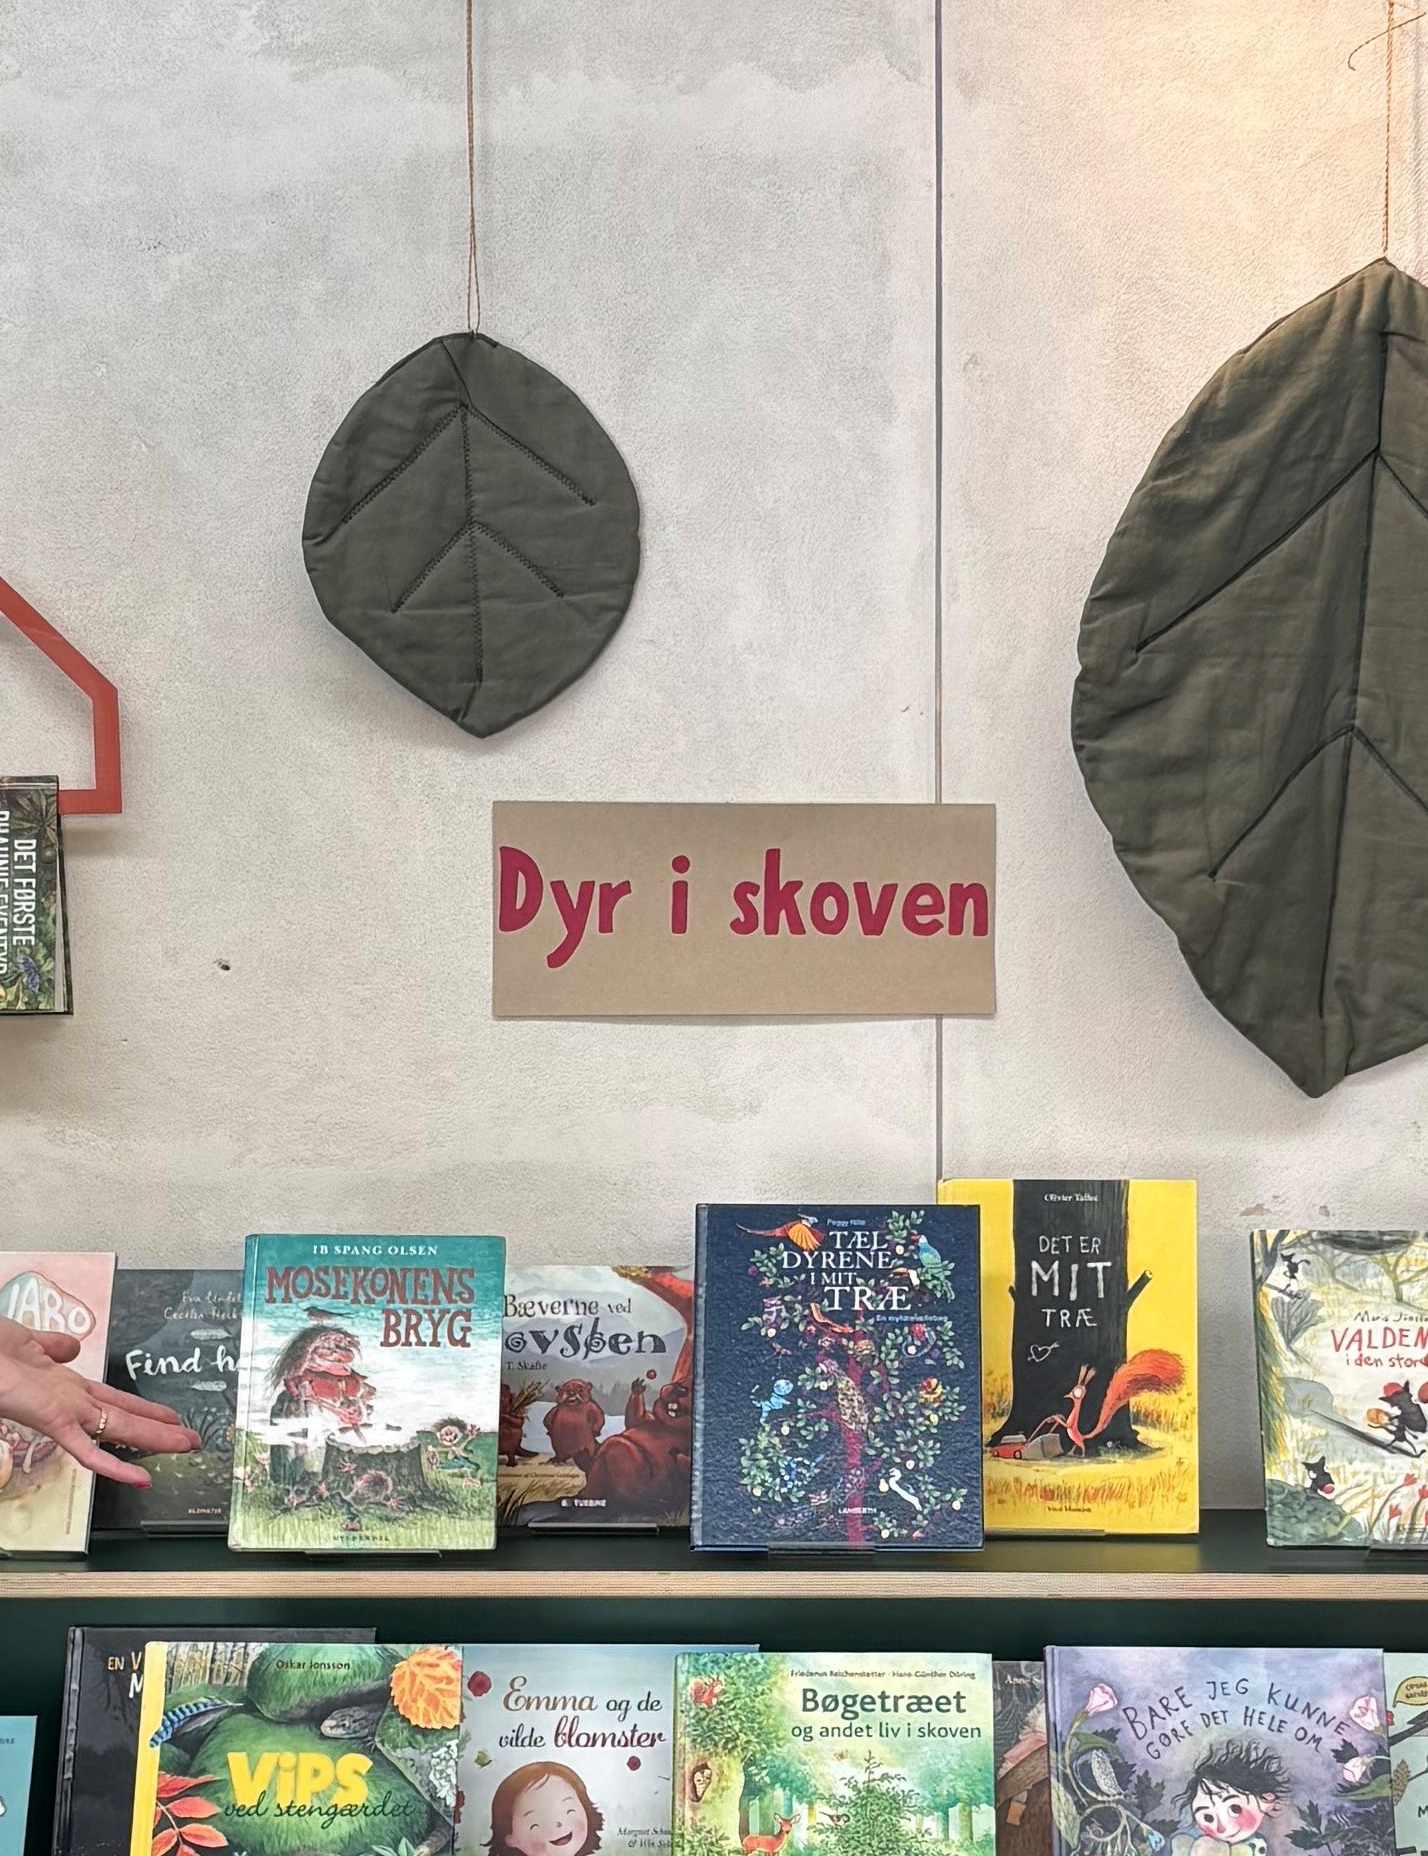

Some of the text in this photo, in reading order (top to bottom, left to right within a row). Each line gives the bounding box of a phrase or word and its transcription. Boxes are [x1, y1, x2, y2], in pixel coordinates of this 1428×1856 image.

[13, 839, 37, 945] DET FØRSTE
[498, 846, 988, 969] Dyr i skoven
[313, 1245, 438, 1256] IB SPANG OLSEN
[829, 1230, 888, 1250] TÆL
[1039, 1235, 1102, 1255] DET ER
[782, 1251, 894, 1269] DYRENE
[265, 1266, 476, 1305] MOSEKONENS
[810, 1272, 858, 1285] I MIT
[1031, 1260, 1112, 1301] MIT
[503, 1294, 632, 1318] Bæverne ved
[824, 1286, 912, 1311] TRÆ
[380, 1309, 472, 1348] BRYG
[1041, 1307, 1098, 1328] TRÆ
[126, 1347, 203, 1380] Find
[1346, 1354, 1383, 1367] i den
[108, 1656, 124, 1670] EN
[276, 1659, 306, 1670] Oskar
[502, 1675, 663, 1722] Emma og de
[802, 1687, 967, 1721] Bøgetræet
[1123, 1678, 1351, 1741] BARE JEG KUNNE
[499, 1715, 667, 1749] vilde blomster
[791, 1722, 981, 1742] og andet liv i skoven
[1201, 1709, 1229, 1729] DET
[1243, 1705, 1288, 1734] HELE
[1294, 1726, 1325, 1753] OM
[224, 1790, 417, 1829] ved stengærdet
